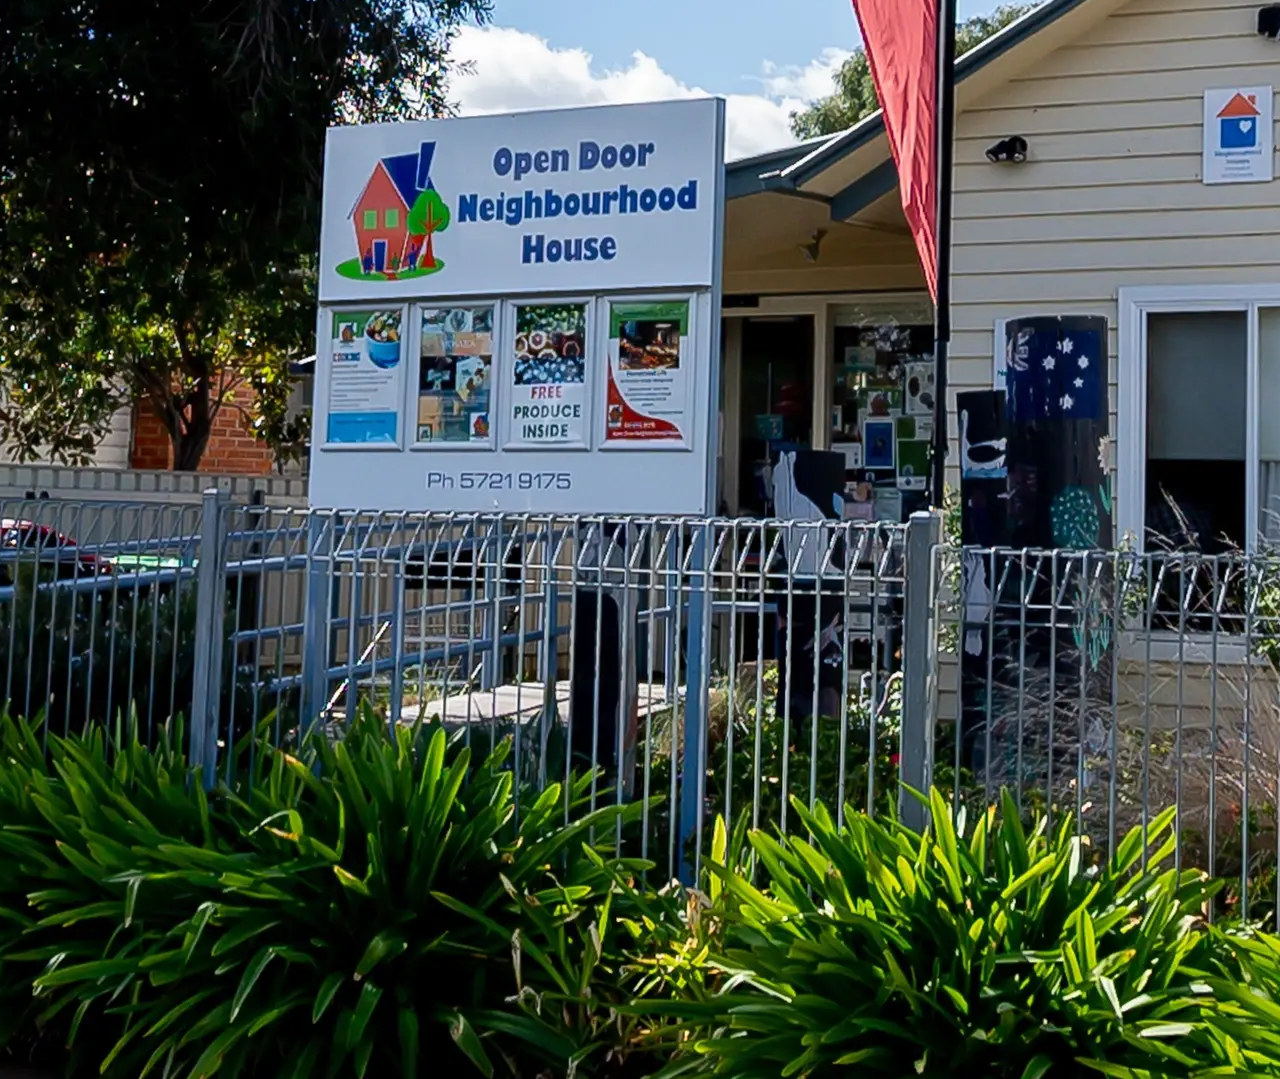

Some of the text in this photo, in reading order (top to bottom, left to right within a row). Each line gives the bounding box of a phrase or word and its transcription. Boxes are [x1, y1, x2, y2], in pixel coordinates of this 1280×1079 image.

[493, 141, 655, 181] Open Door
[457, 180, 698, 226] Neighbourhood
[521, 234, 617, 264] House
[530, 385, 563, 399] FREE
[513, 404, 581, 419] PRODUCE
[522, 423, 569, 438] INSIDE
[427, 472, 571, 489] Ph 5721 9175
